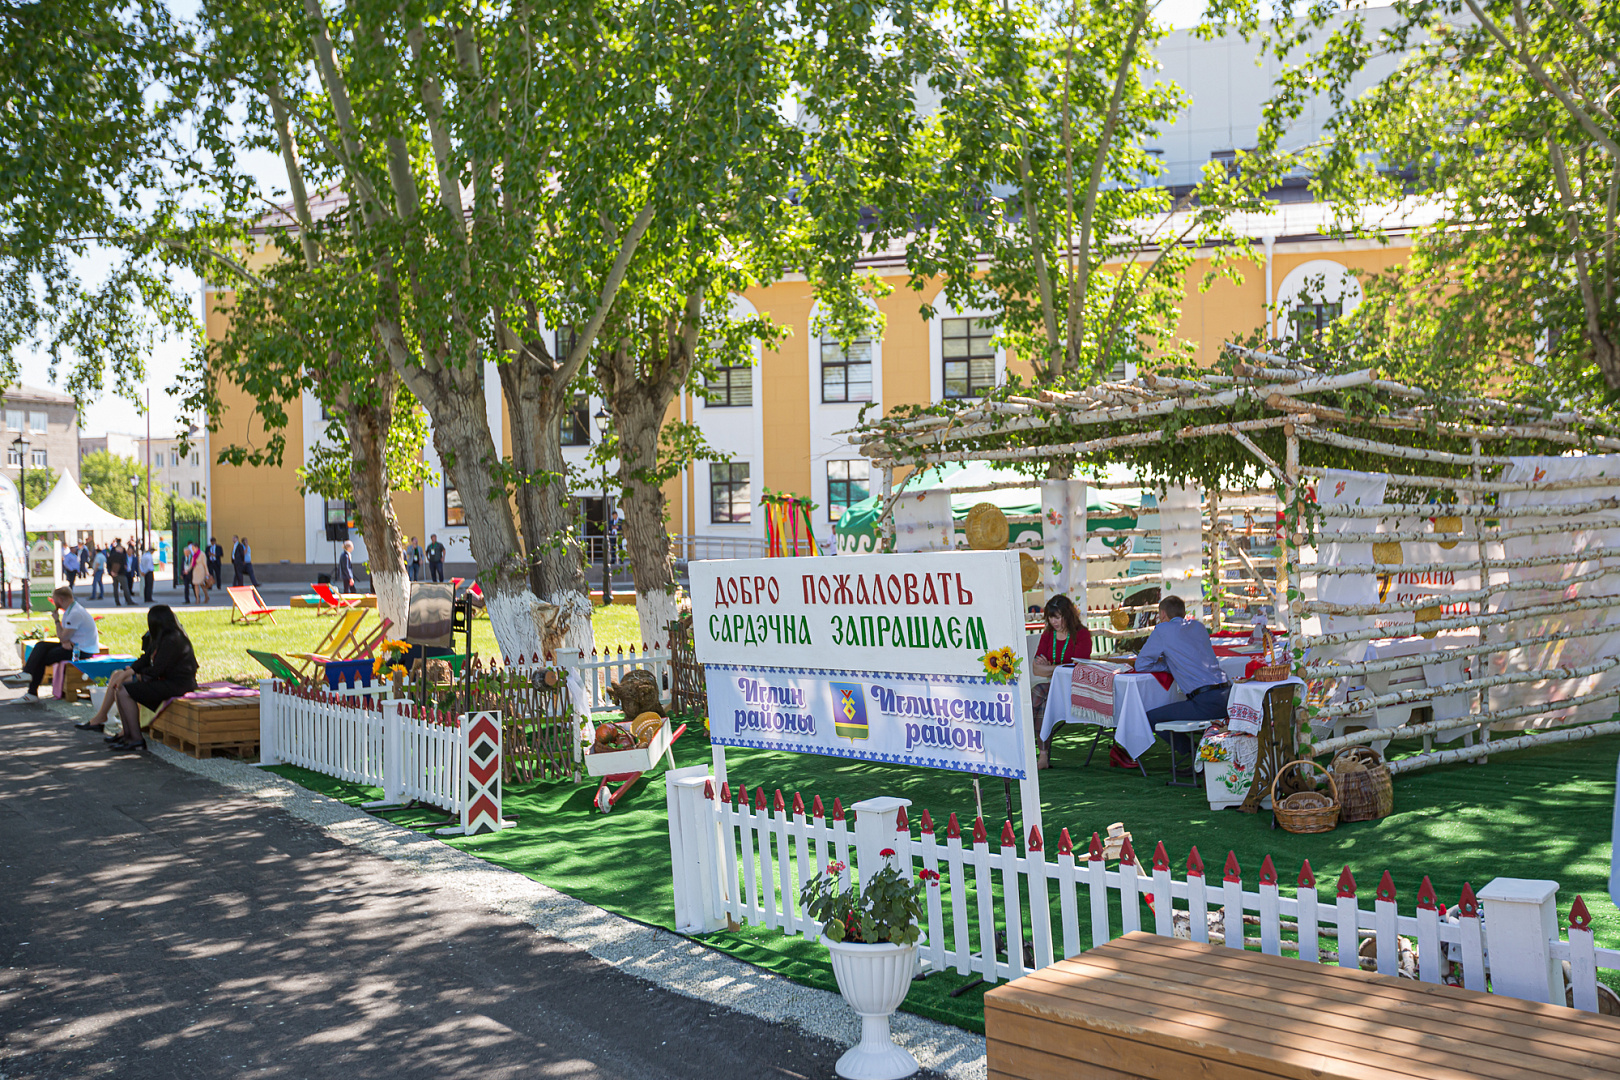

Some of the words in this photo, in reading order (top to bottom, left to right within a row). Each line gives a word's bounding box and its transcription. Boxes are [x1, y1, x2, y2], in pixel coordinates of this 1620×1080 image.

[715, 576, 780, 609] ДОБРО
[802, 573, 974, 605] ПОЖАЛОВАТЬ
[709, 614, 812, 647] САРДЭЧНА
[737, 677, 805, 707] Иглин
[870, 684, 1013, 724] Иглинский
[734, 703, 816, 734] районы
[904, 717, 983, 751] район
